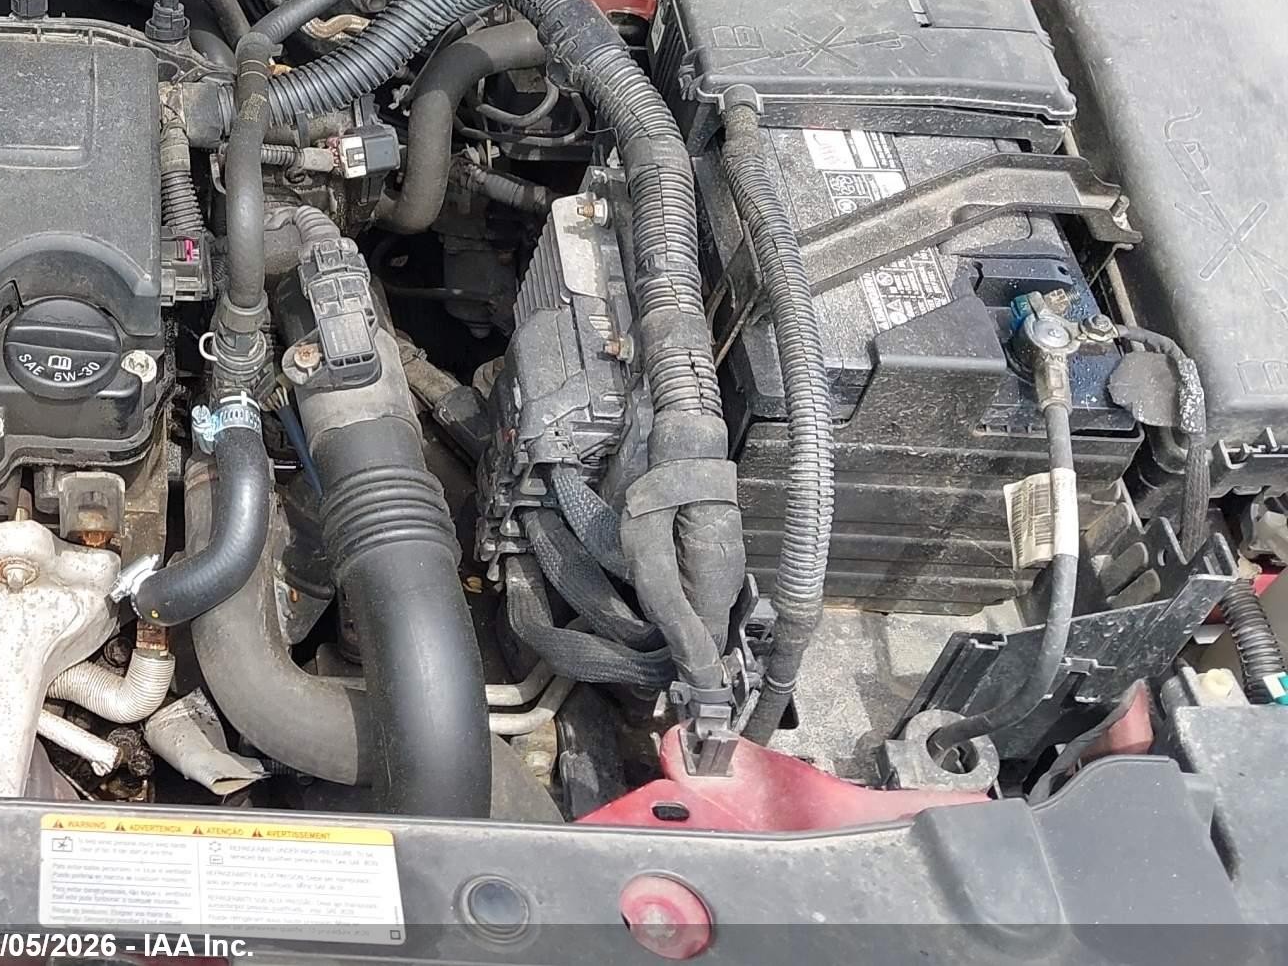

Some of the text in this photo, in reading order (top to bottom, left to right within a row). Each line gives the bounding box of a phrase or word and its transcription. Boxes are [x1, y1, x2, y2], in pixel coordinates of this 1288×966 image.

[18, 353, 102, 383] SAE 5W-30
[68, 821, 106, 830] WARNING
[266, 830, 331, 840] AVERTISSEMENT
